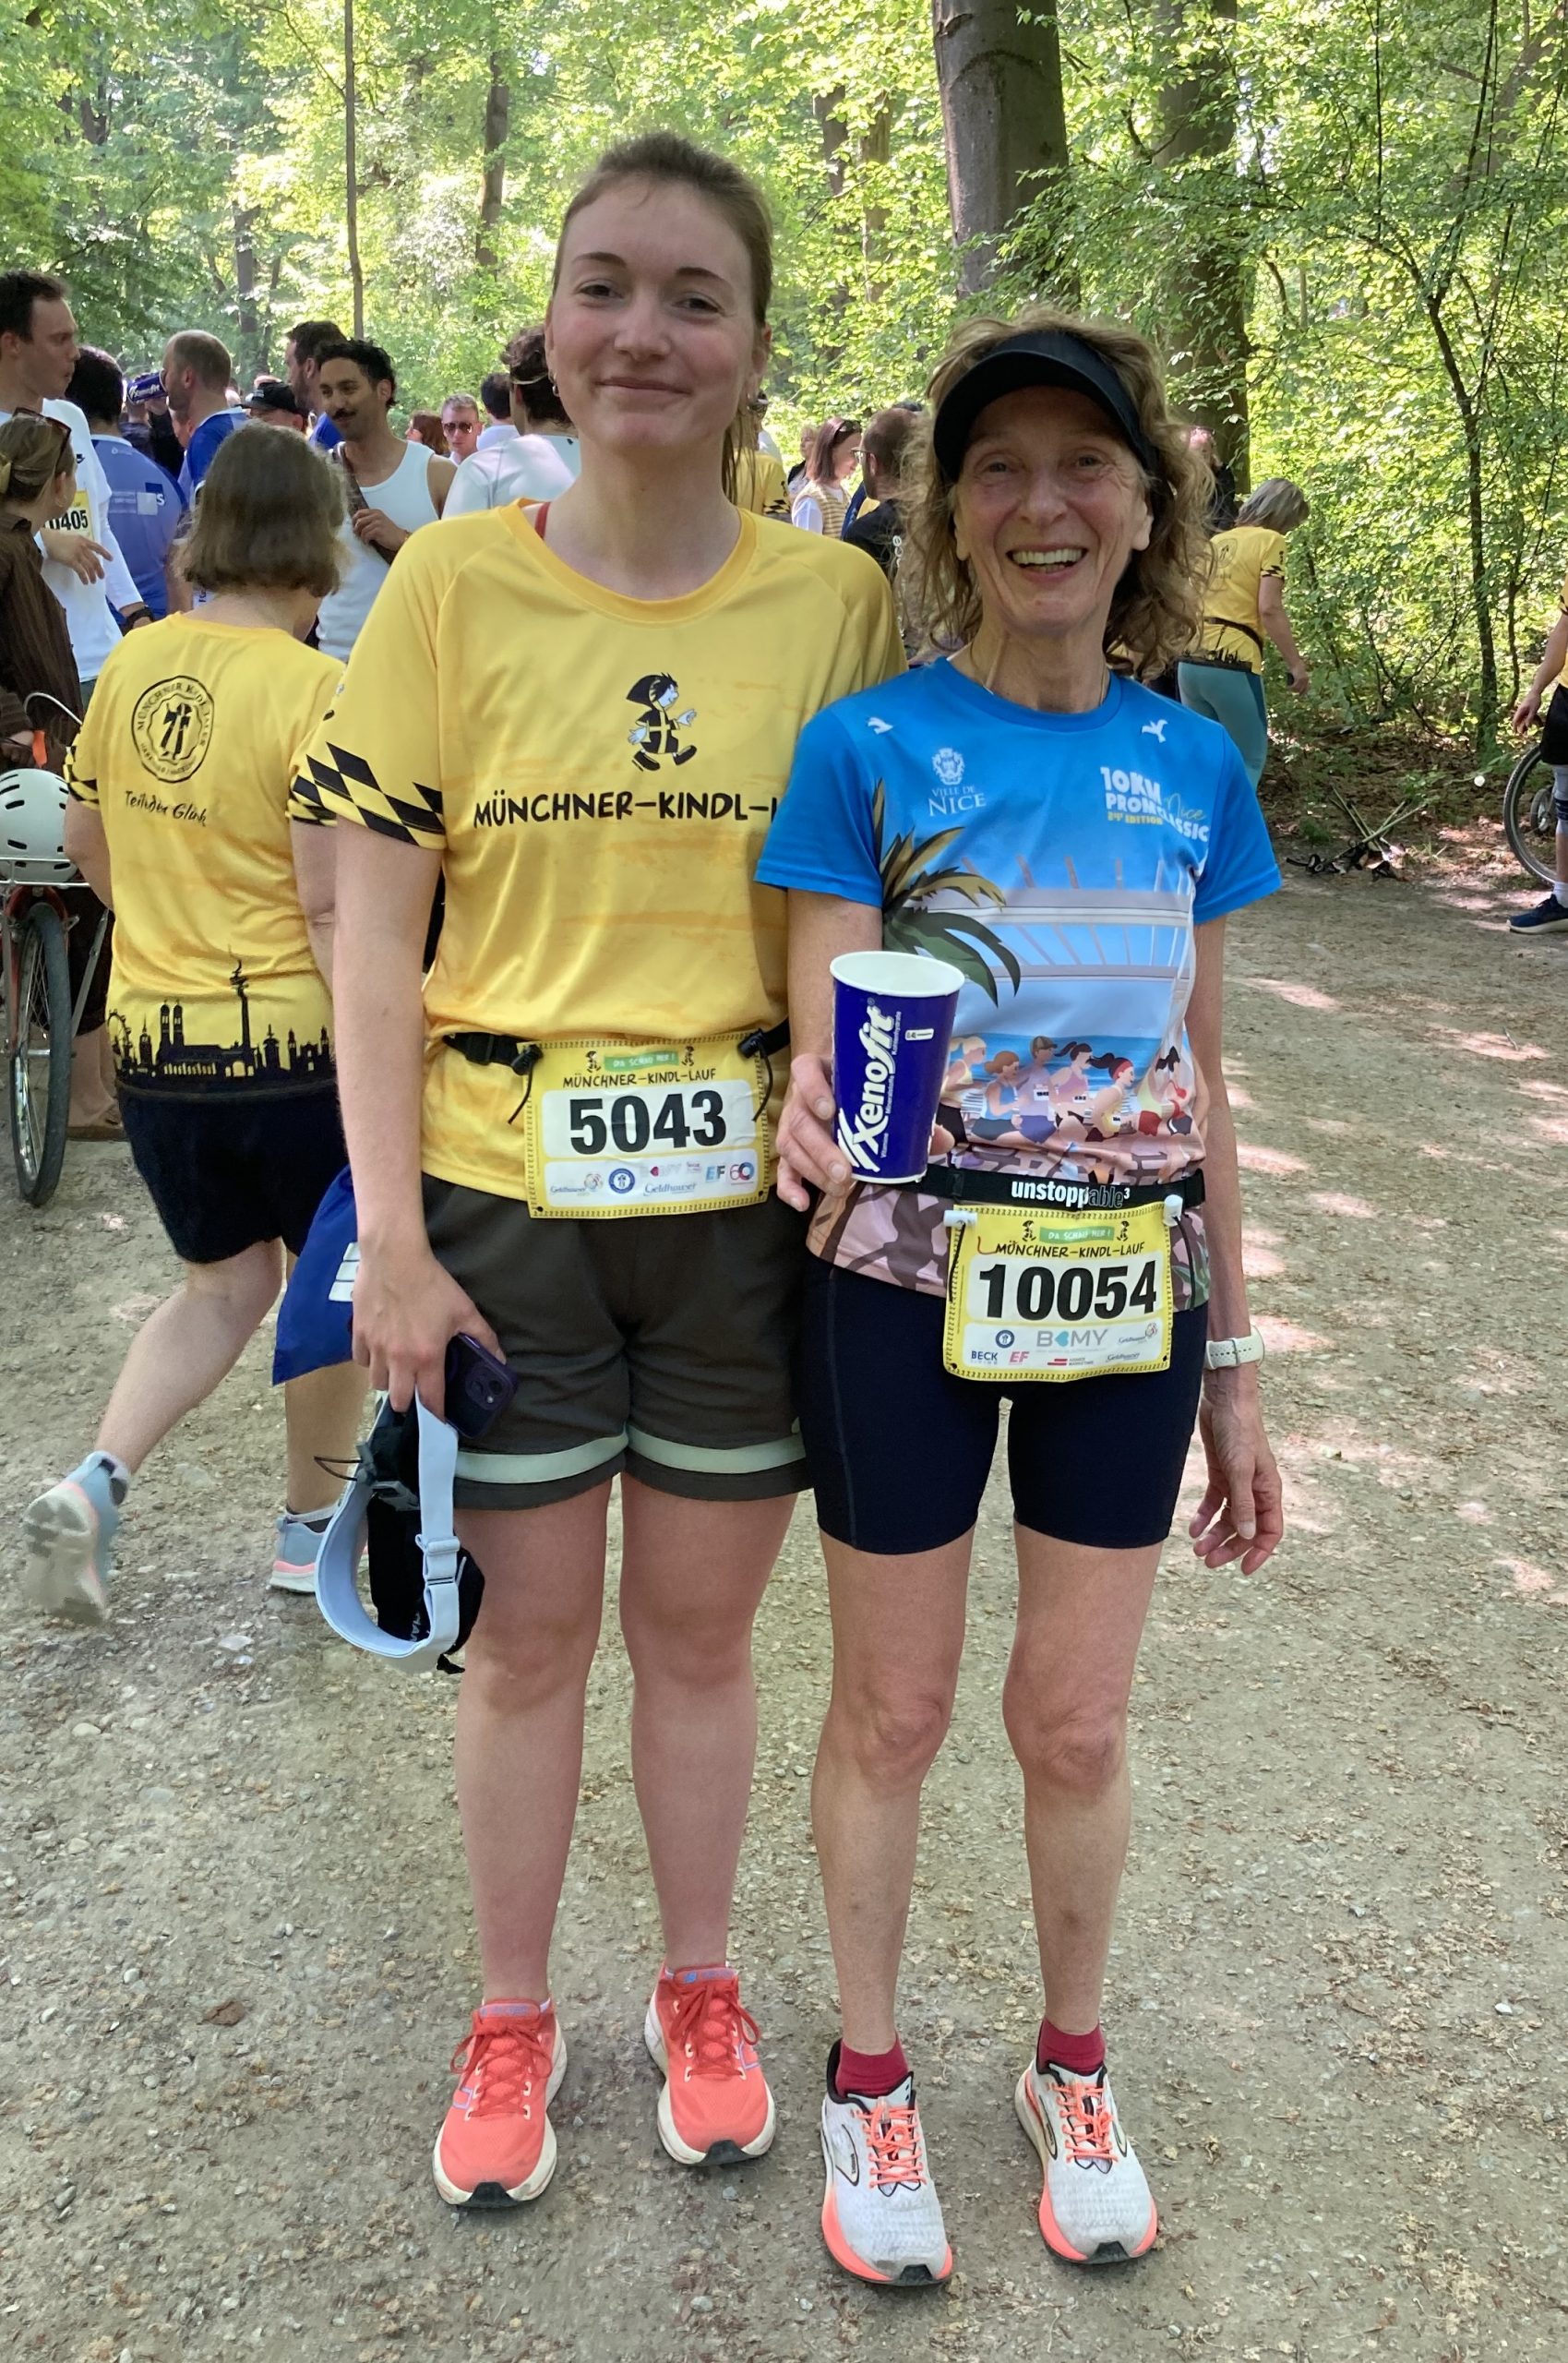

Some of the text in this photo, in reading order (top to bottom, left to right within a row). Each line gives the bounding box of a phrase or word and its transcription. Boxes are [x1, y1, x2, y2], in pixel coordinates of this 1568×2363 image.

[43, 510, 89, 531] 0405
[1100, 766, 1163, 806] 10KM
[928, 792, 987, 817] NICE
[562, 1068, 717, 1088] MÜNCHNER-KINDL-LAUF
[569, 1089, 727, 1155] 5043
[995, 1241, 1145, 1258] MÜNCHNER-KINDL-LAUF
[978, 1259, 1157, 1322] 10054
[971, 1350, 999, 1361] BECK
[1009, 1350, 1030, 1363] EF
